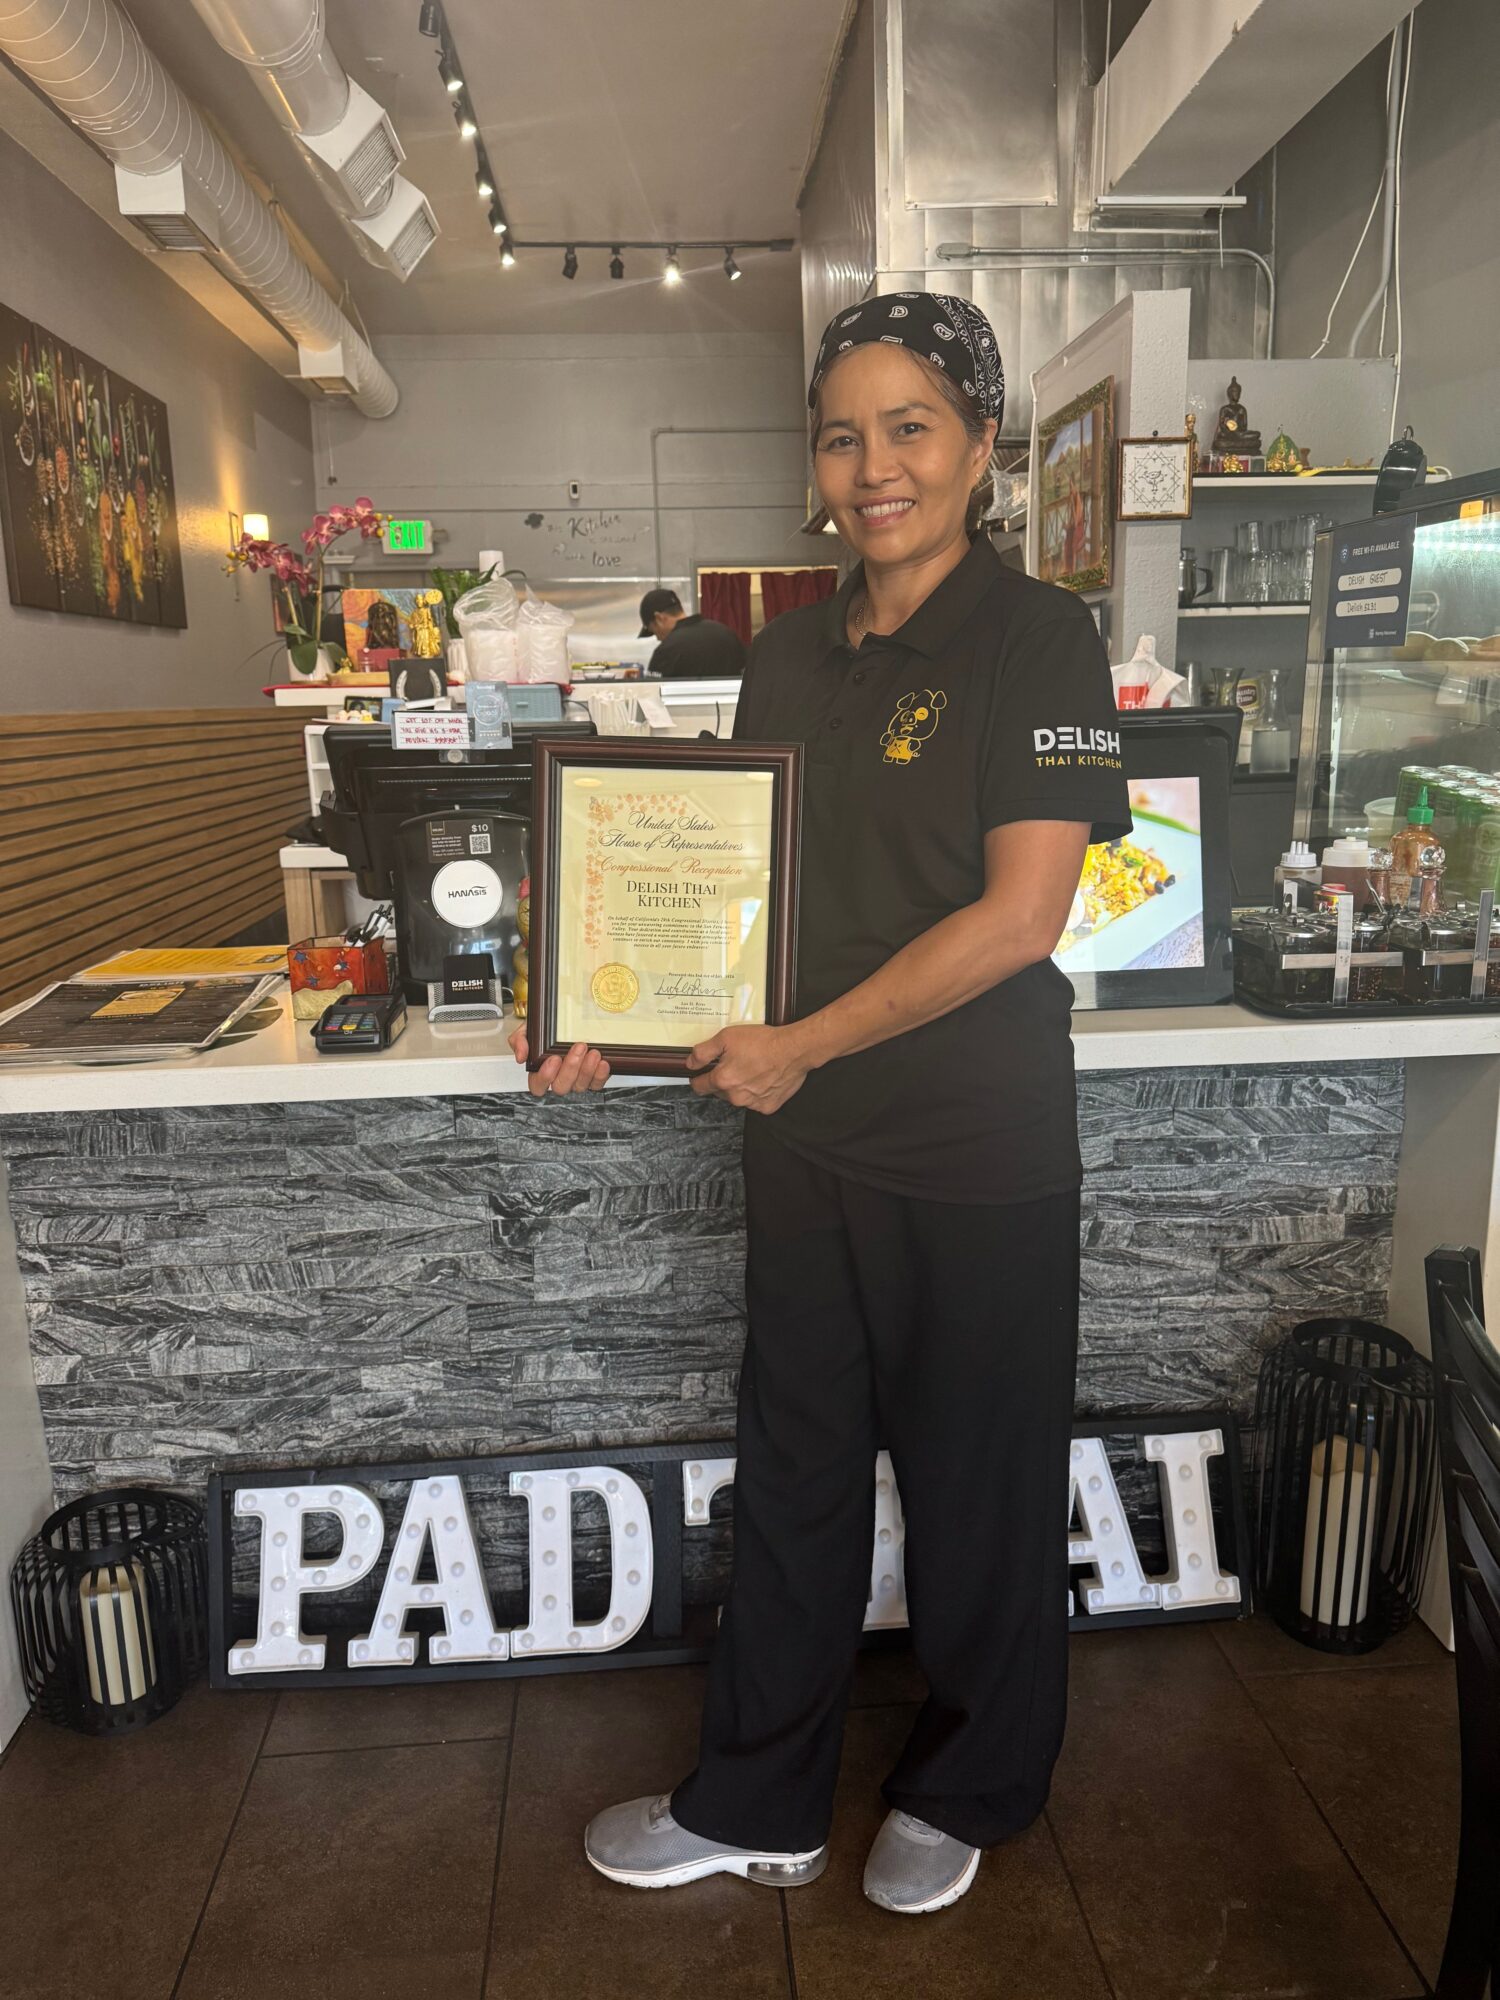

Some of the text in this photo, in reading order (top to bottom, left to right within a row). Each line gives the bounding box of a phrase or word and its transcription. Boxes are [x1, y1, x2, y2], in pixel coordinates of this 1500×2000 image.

[389, 520, 425, 550] EXIT
[1352, 547, 1363, 556] FREE
[1375, 541, 1400, 553] AVAILABLE
[592, 551, 621, 567] love
[1033, 727, 1121, 754] DELISH
[1036, 755, 1122, 769] THAI KITCHEN
[471, 824, 489, 833] $10
[628, 811, 717, 831] United States
[599, 829, 743, 852] House of Representatives
[600, 856, 743, 880] Congressional Recognition
[627, 880, 717, 895] DELISH THAI
[638, 894, 702, 909] KITCHEN
[451, 979, 483, 988] DELISH
[228, 1428, 1242, 1675] PAD AI
